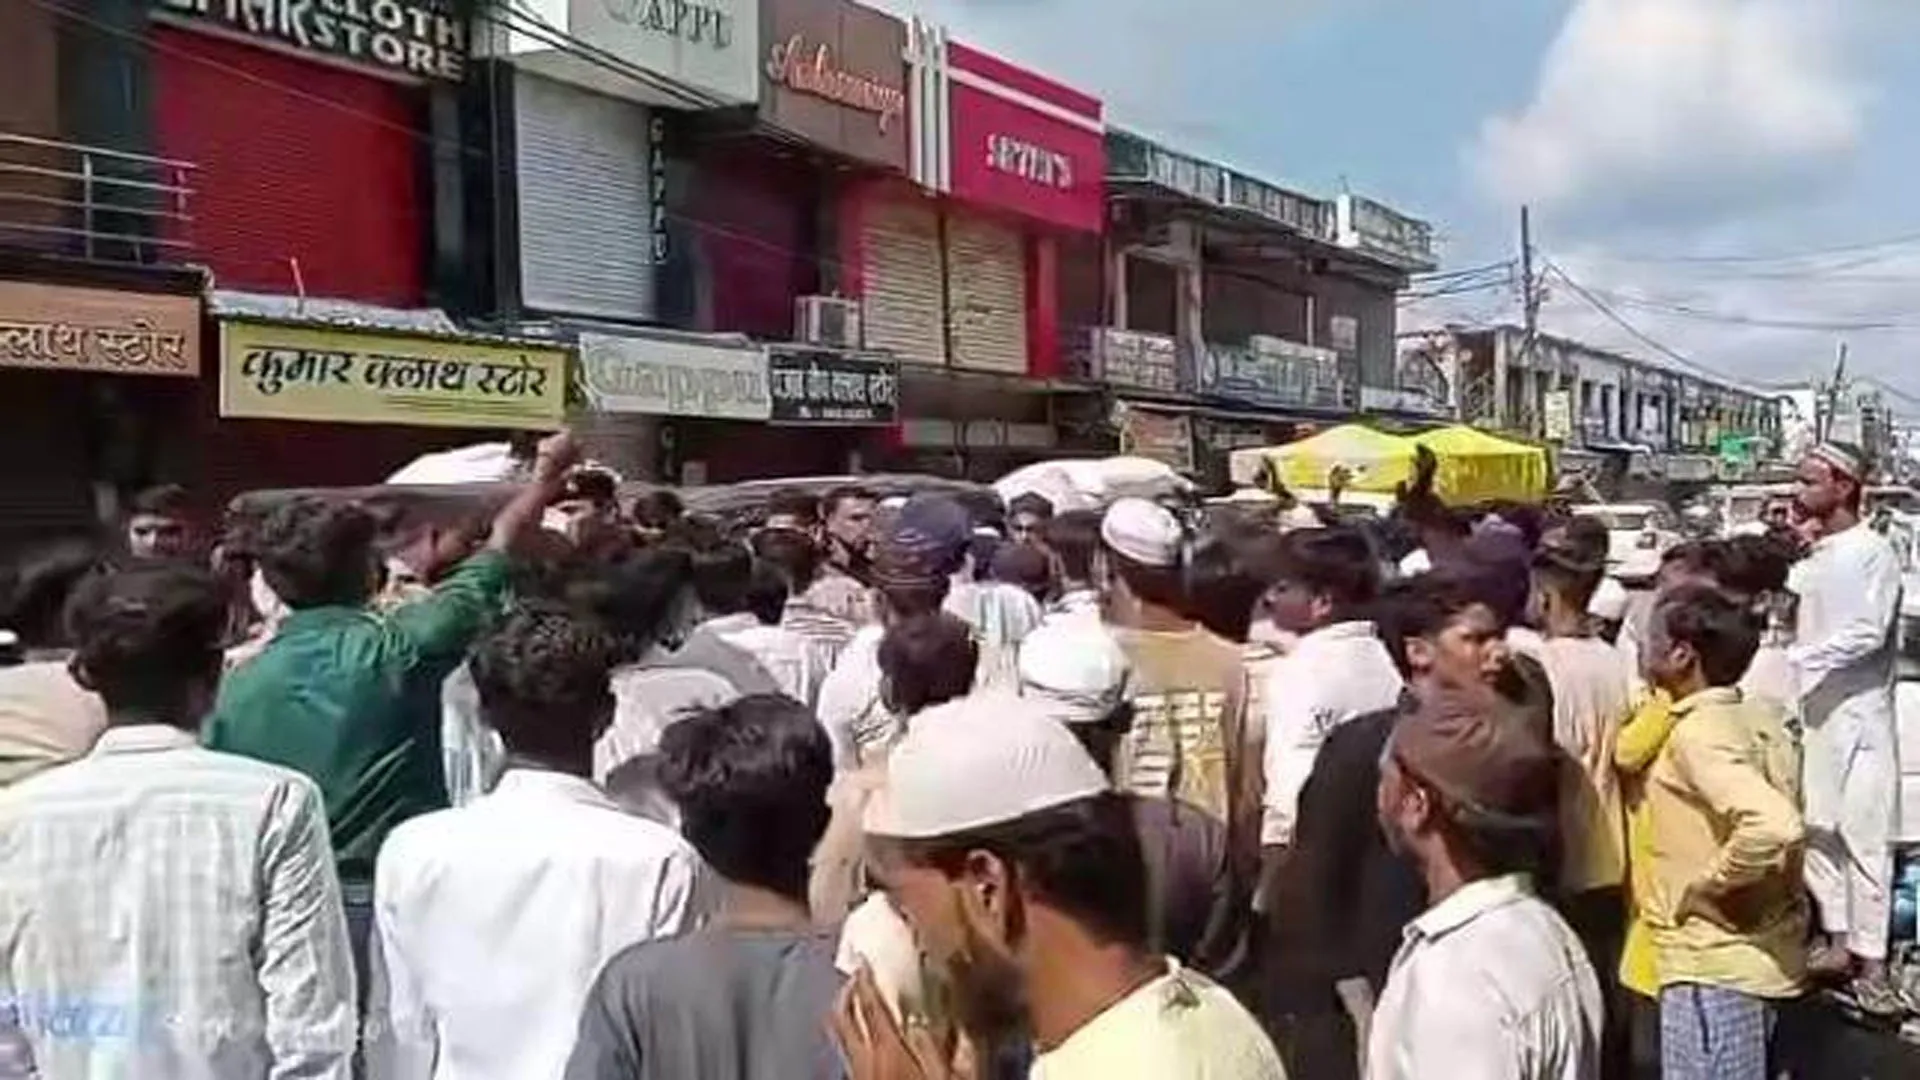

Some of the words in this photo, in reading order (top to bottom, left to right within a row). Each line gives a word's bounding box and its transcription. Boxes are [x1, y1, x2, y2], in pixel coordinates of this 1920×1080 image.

[312, 12, 464, 82] STORE
[95, 315, 189, 370] स्टोर
[241, 344, 354, 395] कुमार
[476, 353, 549, 398] स्टोर
